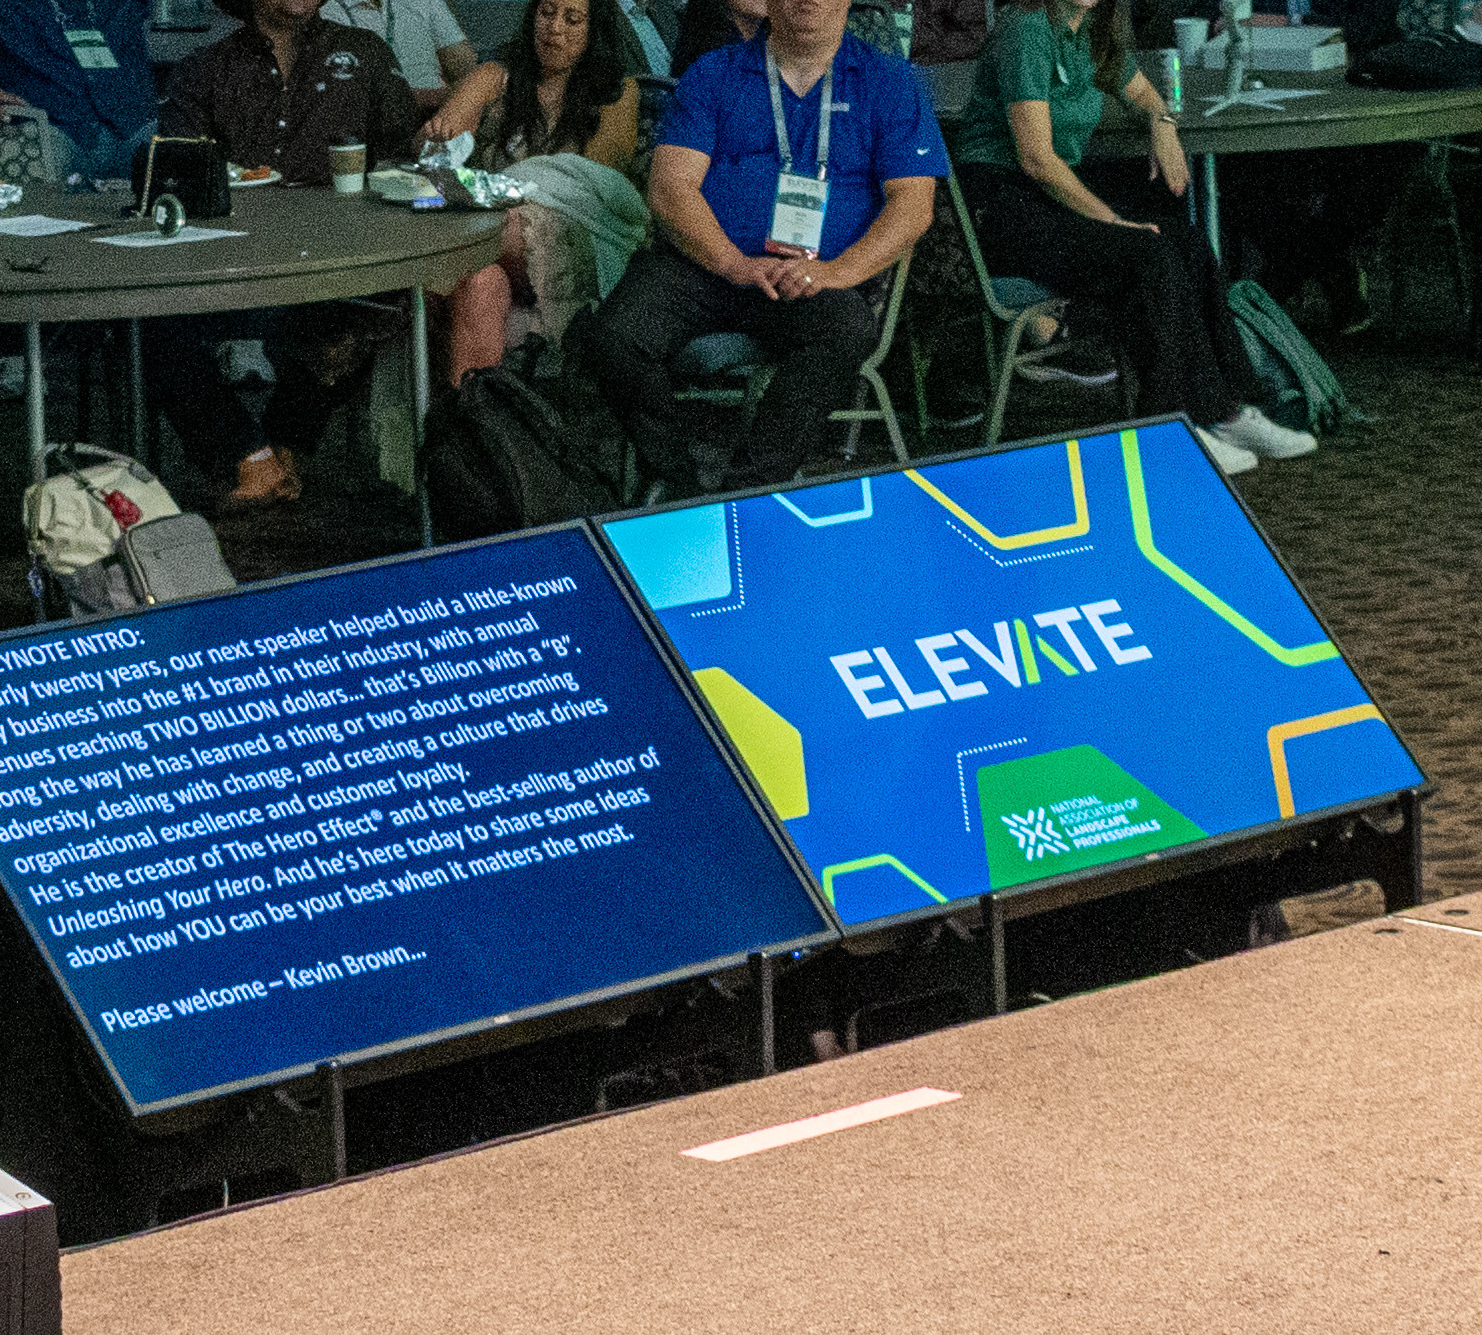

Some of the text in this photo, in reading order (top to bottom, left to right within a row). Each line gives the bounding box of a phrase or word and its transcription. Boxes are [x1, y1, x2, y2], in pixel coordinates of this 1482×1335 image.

[7, 707, 99, 737] business
[98, 698, 142, 718] into
[143, 689, 181, 710] the
[181, 681, 210, 701] #1
[208, 667, 271, 696] brand
[270, 666, 294, 683] in
[294, 655, 341, 679] their
[342, 640, 428, 668] industry,
[428, 627, 473, 650] with
[474, 612, 539, 641] annual
[31, 671, 104, 698] twenty
[105, 660, 168, 688] years,
[169, 651, 203, 671] our
[207, 640, 254, 663] next
[254, 627, 328, 657] speaker
[329, 608, 399, 638] helped
[397, 598, 450, 624] build
[451, 600, 465, 614] a
[463, 577, 577, 611] little-known
[70, 628, 145, 657] INTRO:
[829, 598, 1153, 720] ELEVATE
[39, 777, 79, 798] the
[79, 769, 122, 790] way
[122, 762, 154, 781] he
[152, 754, 192, 775] has
[191, 733, 271, 766] learned
[272, 735, 287, 750] a
[287, 723, 344, 746] thing
[343, 717, 364, 735] or
[366, 709, 407, 729] two
[409, 694, 468, 720] about
[468, 672, 579, 708] overcoming
[57, 730, 148, 761] reaching
[143, 716, 198, 742] TWO
[199, 699, 280, 731] BILLION
[420, 660, 482, 684] Billion
[482, 647, 527, 671] with
[528, 648, 542, 662] a
[97, 793, 175, 821] dealing
[173, 779, 221, 804] with
[223, 767, 301, 794] change,
[302, 752, 342, 777] and
[344, 739, 425, 768] creating
[423, 736, 438, 751] a
[440, 721, 508, 747] culture
[507, 709, 550, 732] that
[551, 698, 608, 723] drives
[14, 762, 470, 874] organizational excellence and customer loyalty.
[29, 884, 63, 905] He
[62, 879, 84, 898] is
[84, 872, 123, 893] the
[125, 856, 197, 885] creator
[202, 845, 223, 868] of
[222, 841, 266, 862] The
[265, 830, 318, 853] Hero
[389, 800, 429, 826] and
[428, 796, 465, 817] the
[463, 772, 576, 808] best-selling
[574, 757, 636, 784] author
[639, 746, 660, 768] of
[48, 898, 165, 936] Unleashing
[164, 886, 210, 910] Your
[215, 875, 271, 900] Hero.
[274, 859, 316, 886] And
[357, 844, 407, 866] here
[407, 830, 464, 855] today
[464, 825, 489, 842] to
[490, 812, 544, 837] share
[545, 800, 598, 824] some
[596, 787, 650, 811] ideas
[1049, 794, 1103, 814] NATIONAL
[1059, 797, 1139, 826] ASSOCIATION OF
[1065, 814, 1130, 838] LANDSCAPE
[1073, 818, 1161, 849] PROFESSIONALS
[66, 824, 634, 968] about how YOU can be your best when it matters the most.
[101, 1003, 172, 1033] Please
[172, 981, 267, 1015] welcome
[284, 961, 343, 989] Kevin
